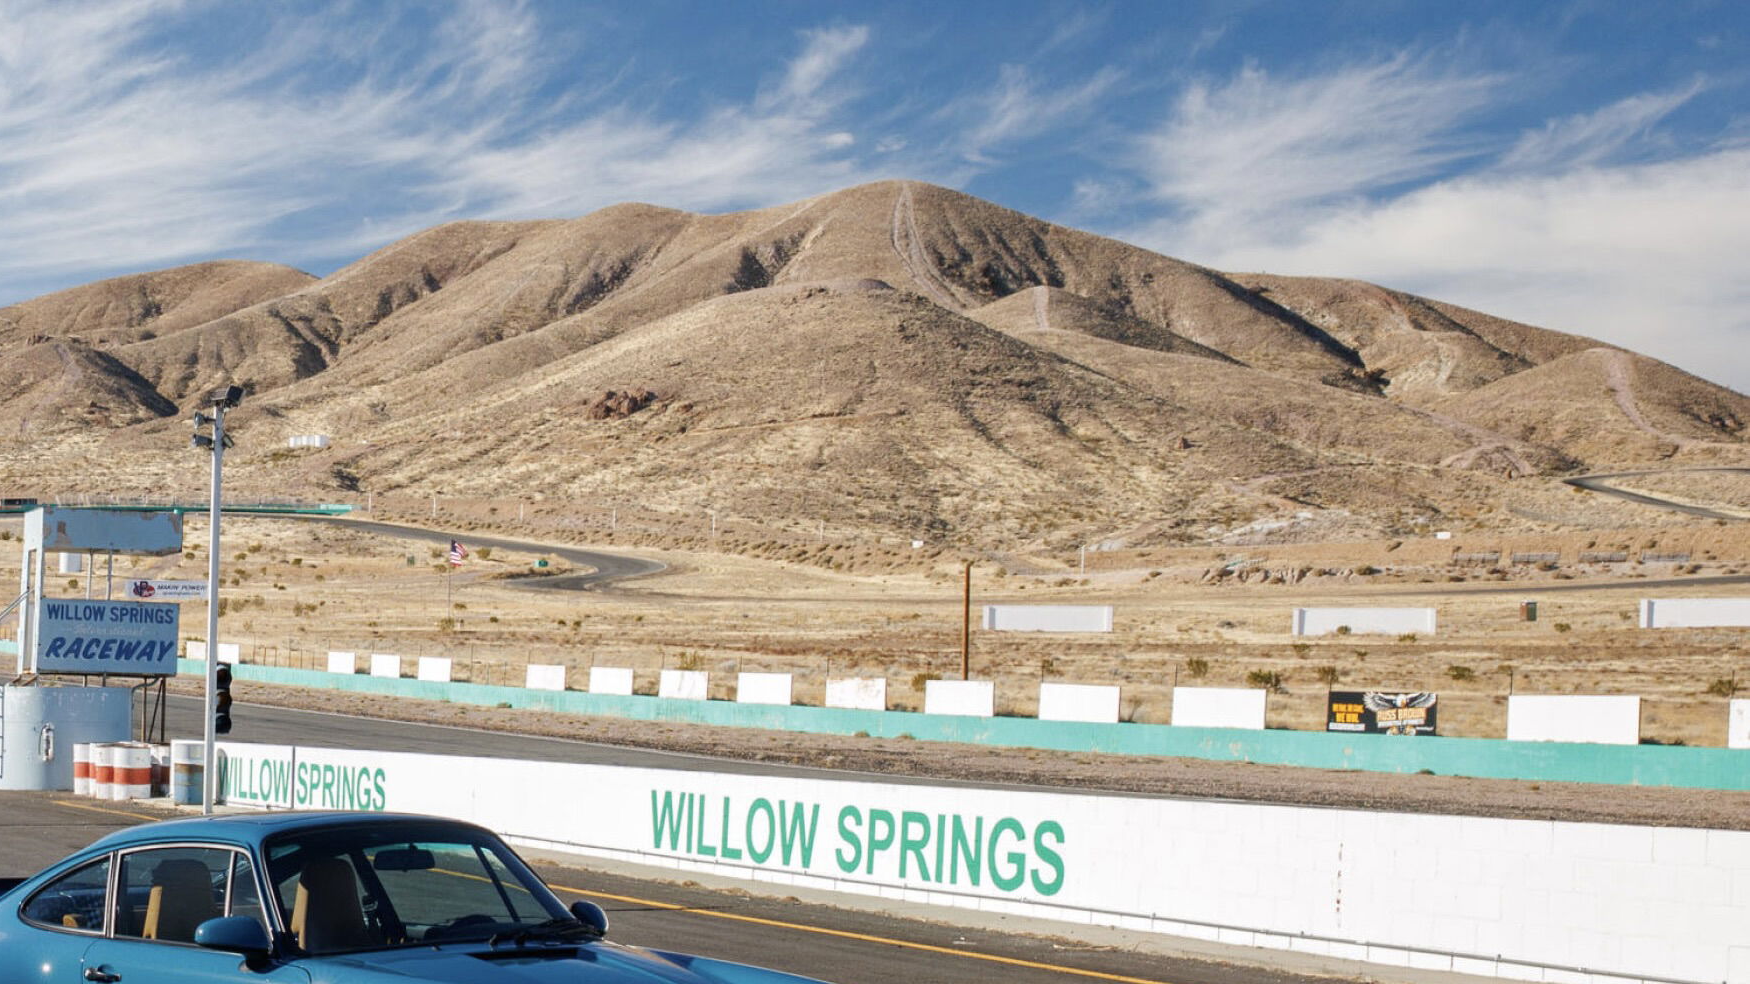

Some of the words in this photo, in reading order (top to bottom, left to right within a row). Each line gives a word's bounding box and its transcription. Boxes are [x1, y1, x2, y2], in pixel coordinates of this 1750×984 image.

[47, 604, 106, 621] WILLOW
[110, 607, 174, 624] SPRINGS
[45, 636, 174, 662] RACEWAY
[218, 757, 291, 803] WILLOW
[296, 761, 386, 811] SPRINGS
[651, 789, 820, 869] WILLOW
[835, 804, 1065, 896] SPRINGS
